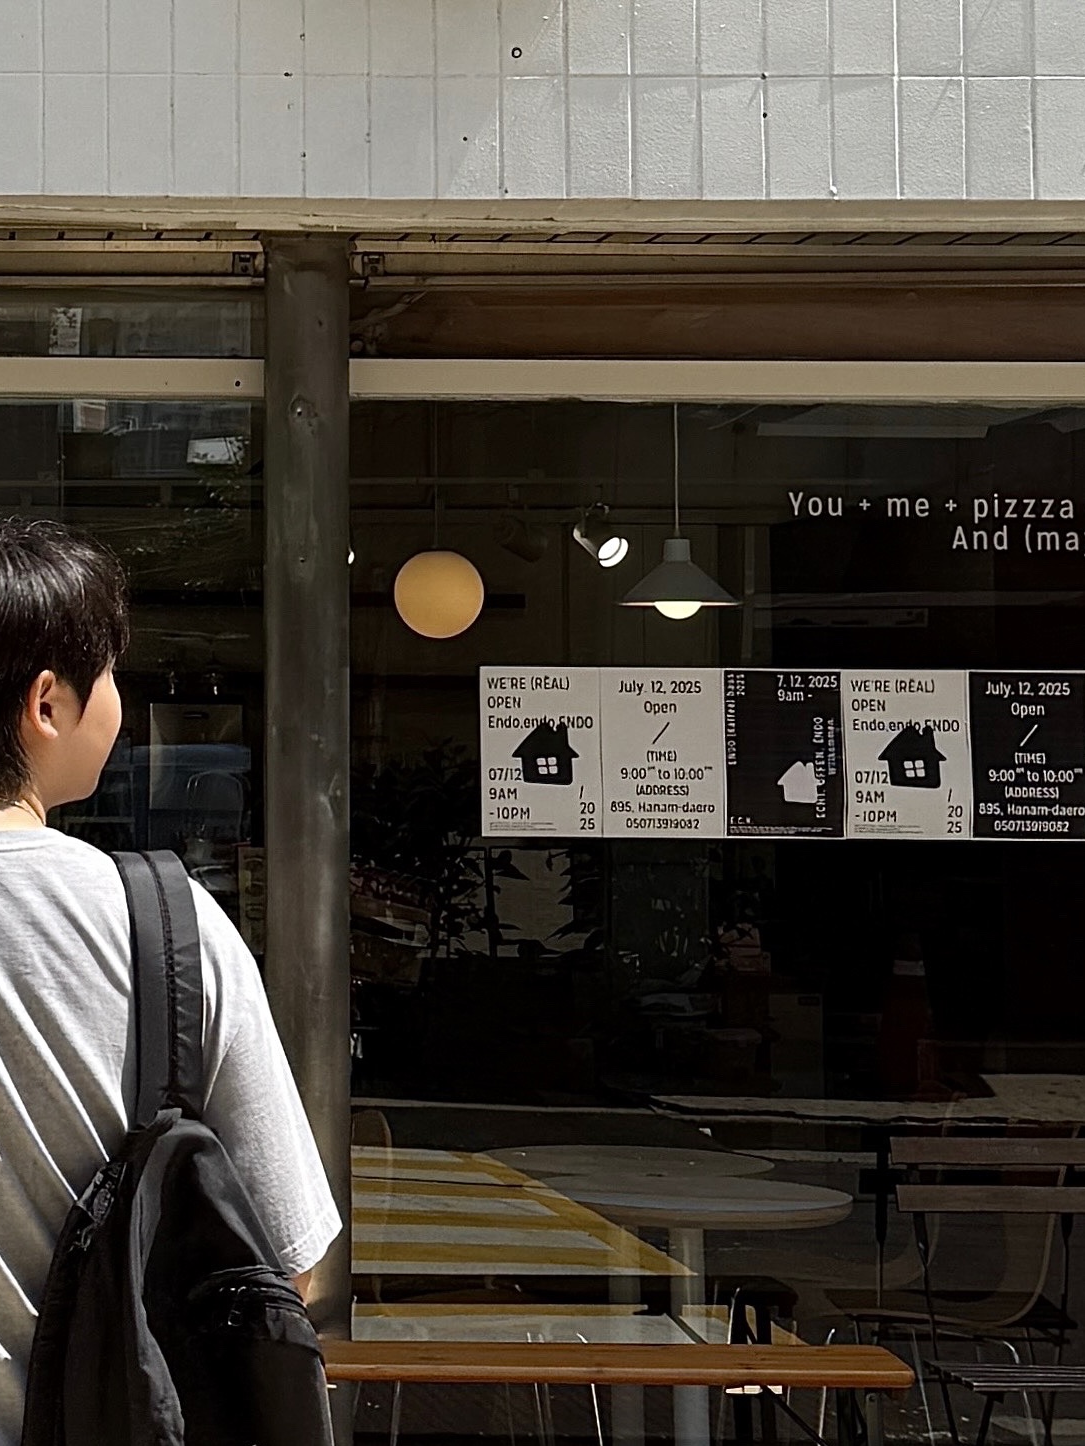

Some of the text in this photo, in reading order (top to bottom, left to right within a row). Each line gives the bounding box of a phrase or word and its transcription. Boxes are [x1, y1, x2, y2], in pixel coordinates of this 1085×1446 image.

[788, 491, 843, 517] You
[887, 497, 930, 517] me
[973, 493, 1075, 524] pizzza
[951, 523, 1085, 557] And (ma
[487, 676, 526, 690] WE'RE
[670, 680, 702, 694] 2025
[808, 675, 838, 688] 2025
[850, 679, 891, 693] WE'RE
[777, 690, 804, 702] 9am
[985, 681, 1015, 698] July.
[1038, 681, 1070, 696] 2025
[487, 696, 521, 709] OPEN
[643, 700, 677, 715] Open
[851, 698, 886, 712] OPEN
[1011, 702, 1045, 718] Open
[812, 716, 825, 744] ENDO
[646, 750, 677, 763] (TIME)
[727, 740, 737, 766] ENDO
[1014, 752, 1046, 765] (TIME)
[489, 768, 523, 781] 07/12
[658, 767, 671, 780] to
[855, 770, 889, 784] 07/12
[1027, 770, 1039, 783] to
[489, 788, 517, 800] 9AM
[635, 784, 690, 796] (ADDRESS)
[855, 790, 885, 803] 9AM
[1004, 786, 1059, 799] (ADDRESS)
[580, 802, 596, 815] 20
[638, 801, 715, 813] Hanam-daero
[947, 805, 963, 818] 20
[1007, 803, 1085, 816] Hanam-daero
[580, 818, 596, 830] 25
[947, 821, 962, 834] 25
